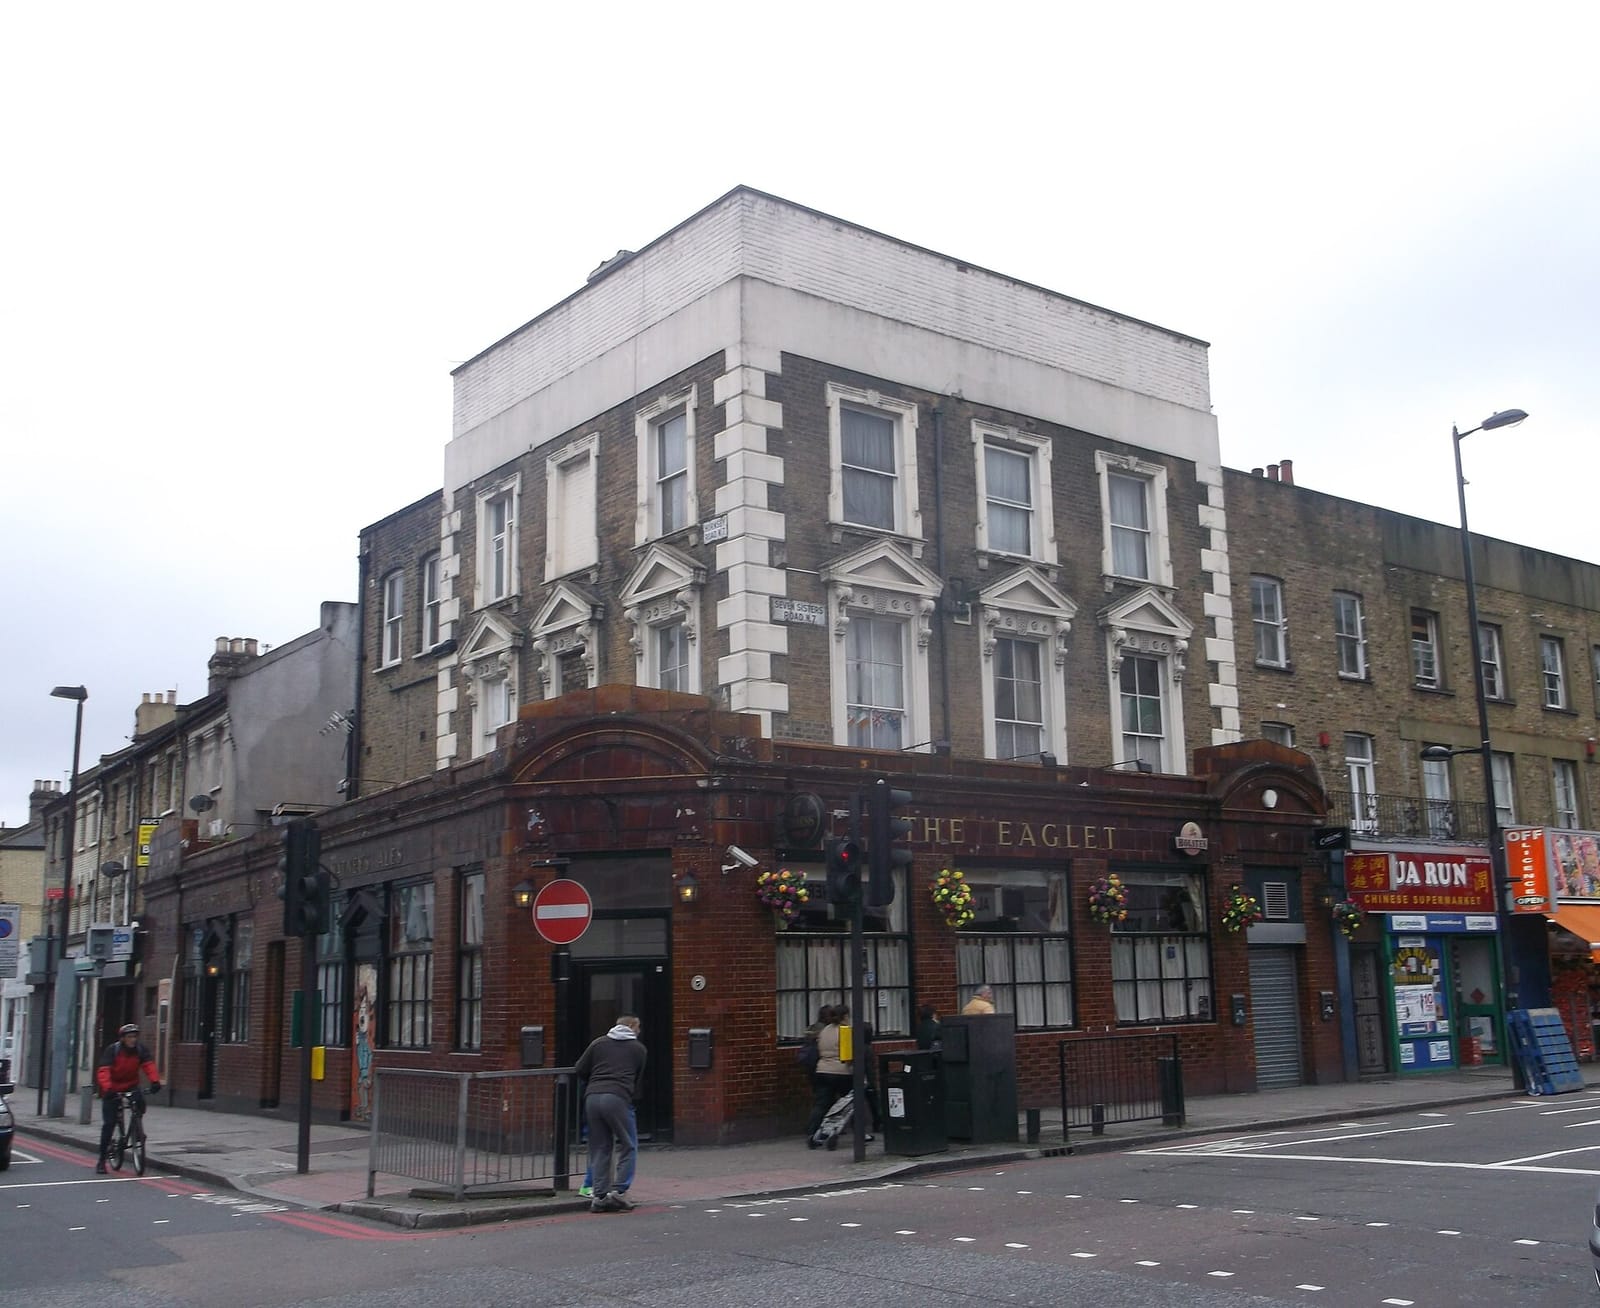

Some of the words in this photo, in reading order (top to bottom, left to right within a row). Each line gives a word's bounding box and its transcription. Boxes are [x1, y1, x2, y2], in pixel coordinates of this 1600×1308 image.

[774, 600, 795, 612] SEVEN
[796, 603, 824, 615] SISTERS
[783, 611, 804, 621] ROAD
[901, 816, 965, 844] THE
[998, 821, 1117, 850] EAGLET
[1507, 829, 1543, 842] OFF
[1395, 860, 1420, 885] UA
[1423, 861, 1467, 887] RUN
[1520, 842, 1537, 895] LICENCE
[1363, 894, 1409, 905] CHINESE
[1412, 895, 1481, 905] SUPERMARKET
[1516, 896, 1545, 905] OPEN
